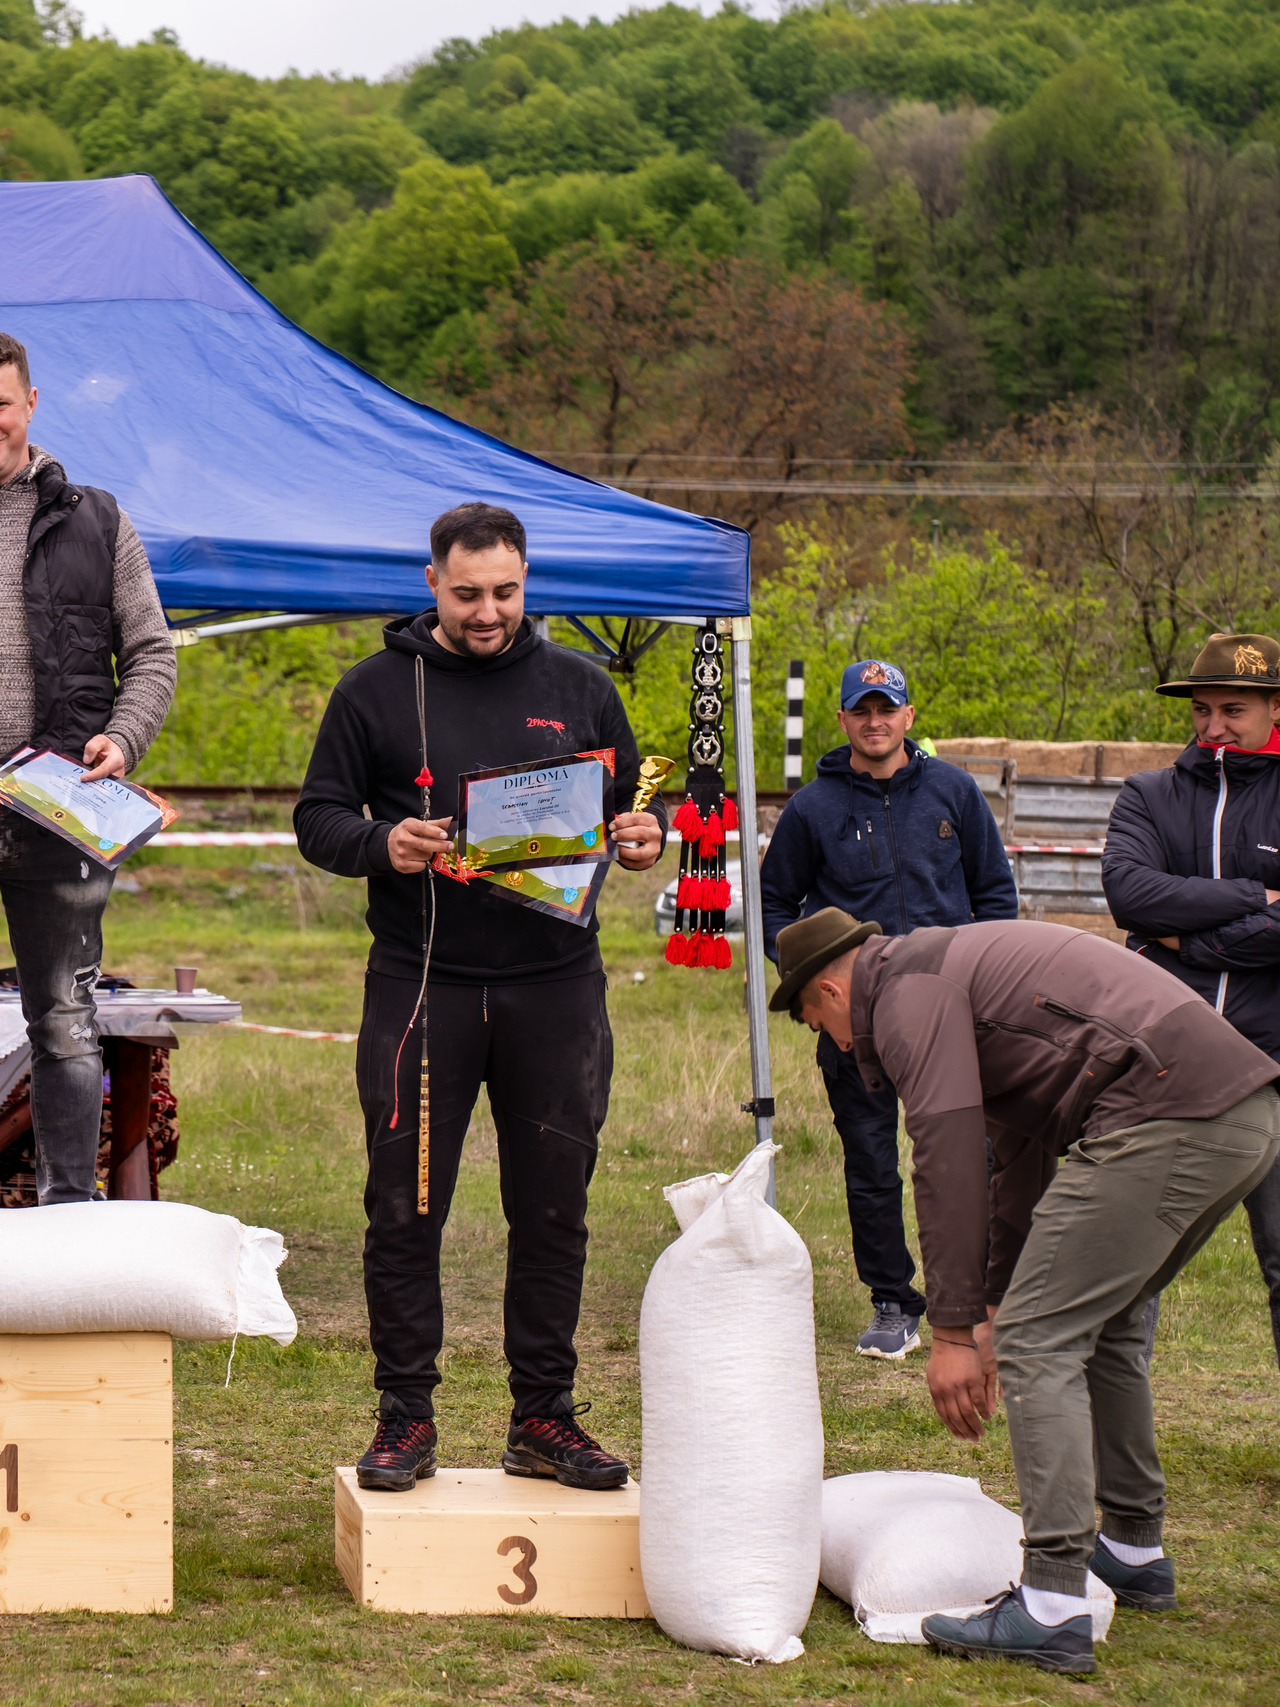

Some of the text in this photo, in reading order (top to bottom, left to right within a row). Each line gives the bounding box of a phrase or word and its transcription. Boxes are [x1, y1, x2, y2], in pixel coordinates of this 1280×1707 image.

[73, 767, 131, 801] DOMĂ
[504, 768, 569, 790] DIPLOMĂ
[496, 1535, 538, 1606] 3
